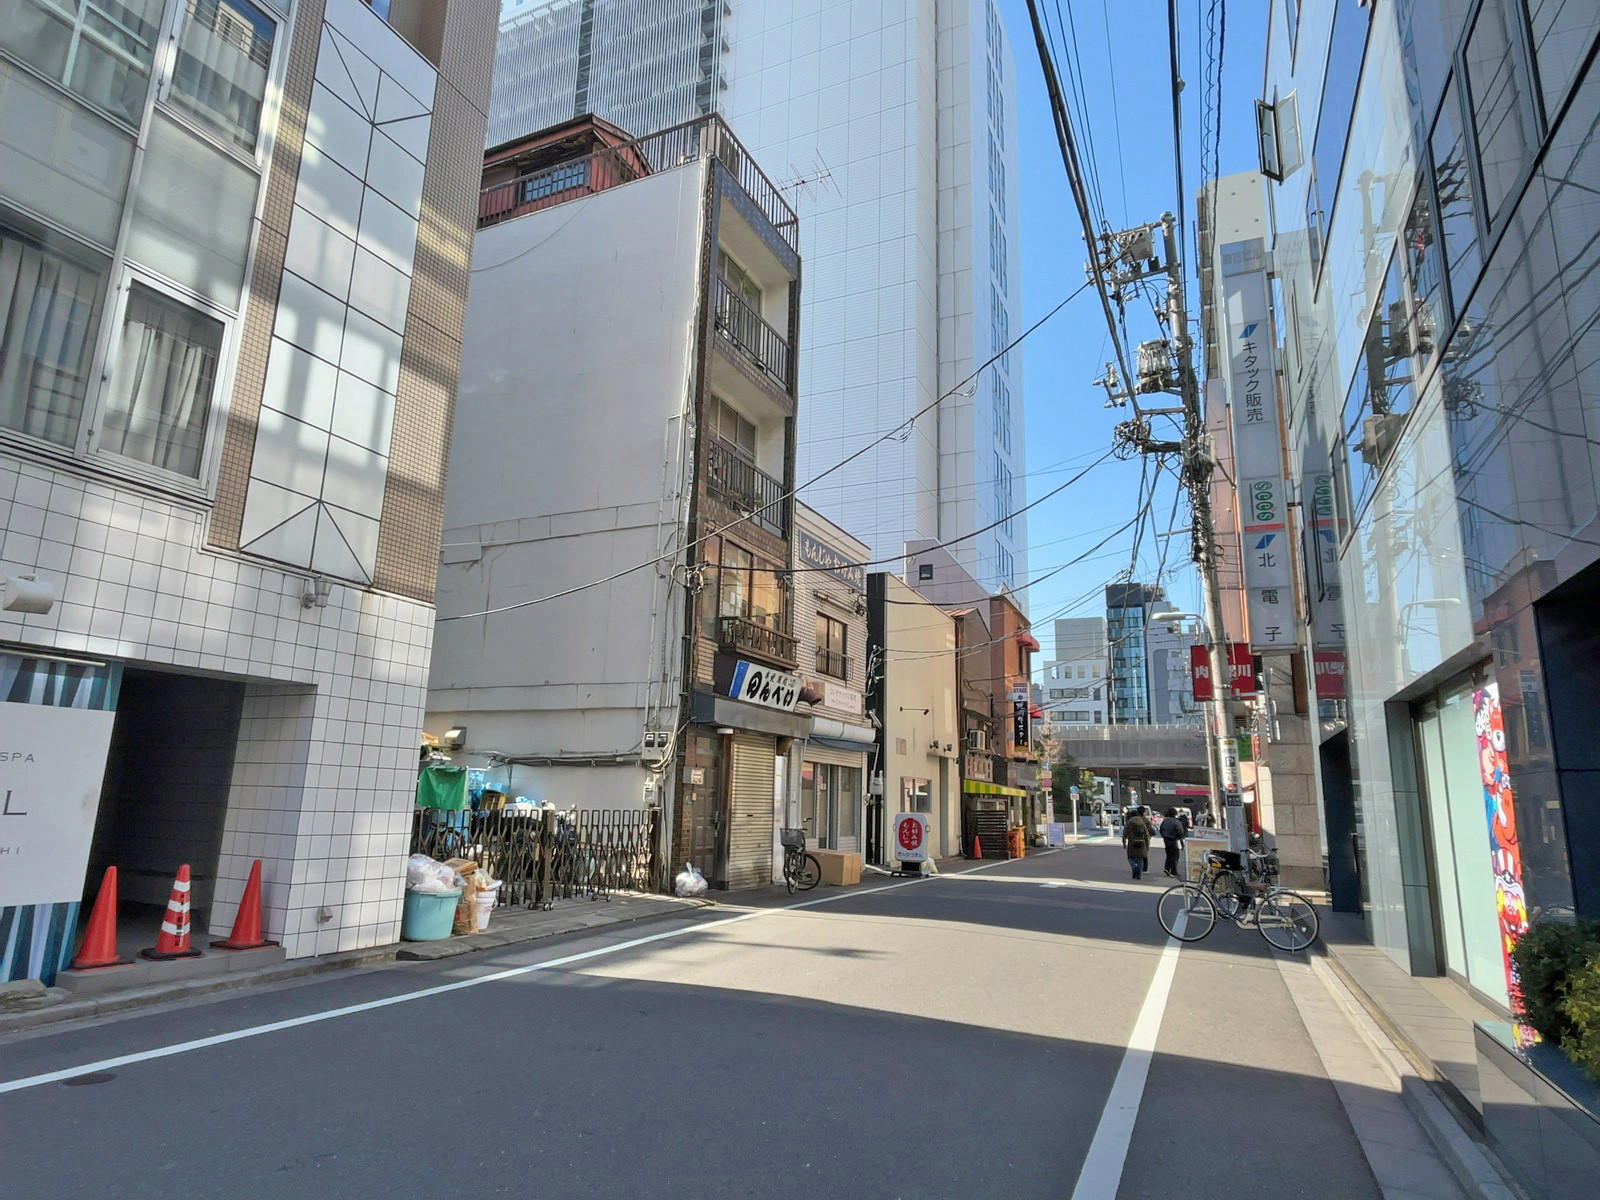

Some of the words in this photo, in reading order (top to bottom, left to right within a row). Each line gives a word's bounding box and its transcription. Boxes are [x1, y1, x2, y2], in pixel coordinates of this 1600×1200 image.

[1242, 341, 1264, 422] キタック販売
[804, 538, 831, 568] もんじゃ
[1258, 552, 1282, 642] 北電子
